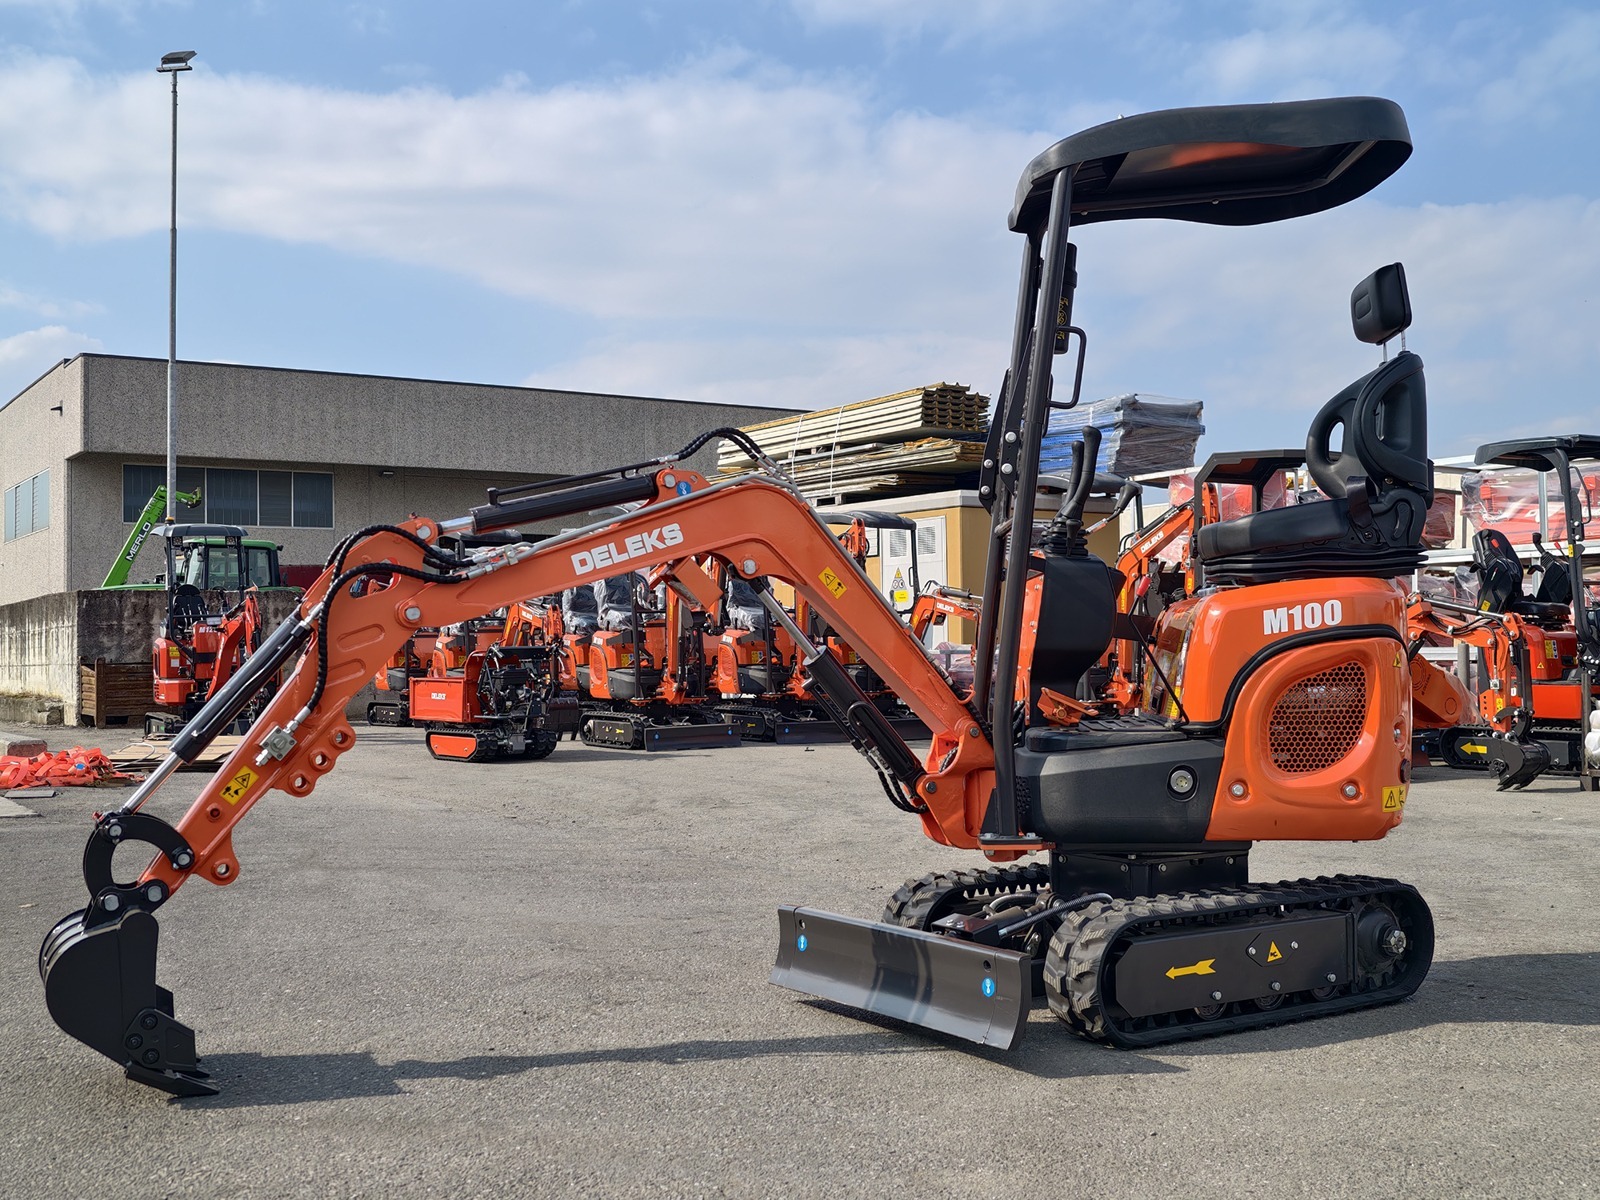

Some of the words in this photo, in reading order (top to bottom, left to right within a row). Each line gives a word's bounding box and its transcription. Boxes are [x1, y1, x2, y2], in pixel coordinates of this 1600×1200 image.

[125, 521, 151, 561] MERLO
[571, 523, 684, 575] DELEKS
[1140, 530, 1165, 553] DELEKS
[1263, 599, 1343, 635] M100
